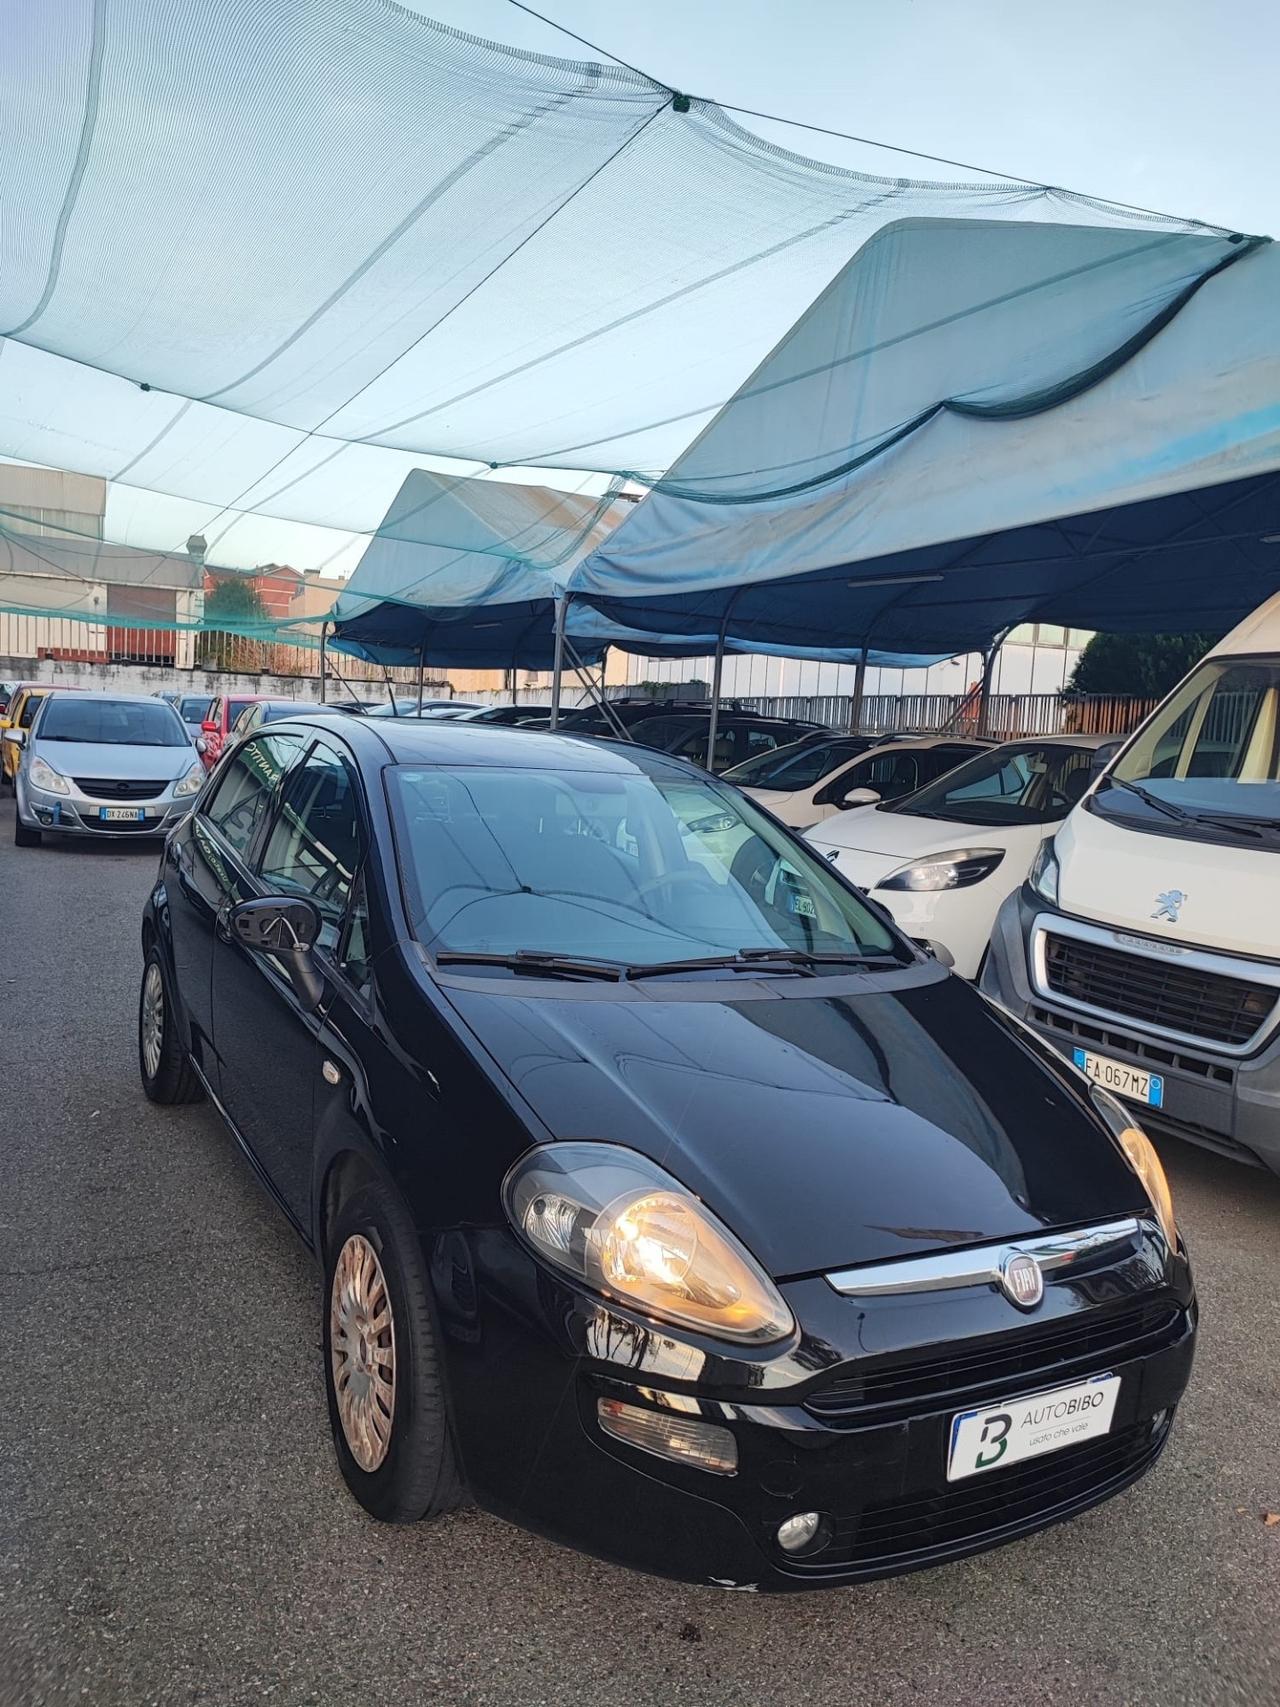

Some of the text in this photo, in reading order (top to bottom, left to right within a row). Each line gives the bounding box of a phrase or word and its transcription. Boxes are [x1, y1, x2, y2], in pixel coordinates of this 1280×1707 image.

[1086, 1057, 1149, 1097] FA 067MZ
[1013, 1266, 1036, 1293] FIAT
[1020, 1391, 1104, 1429] AUTOBIBO
[1029, 1422, 1089, 1447] usato che vale
